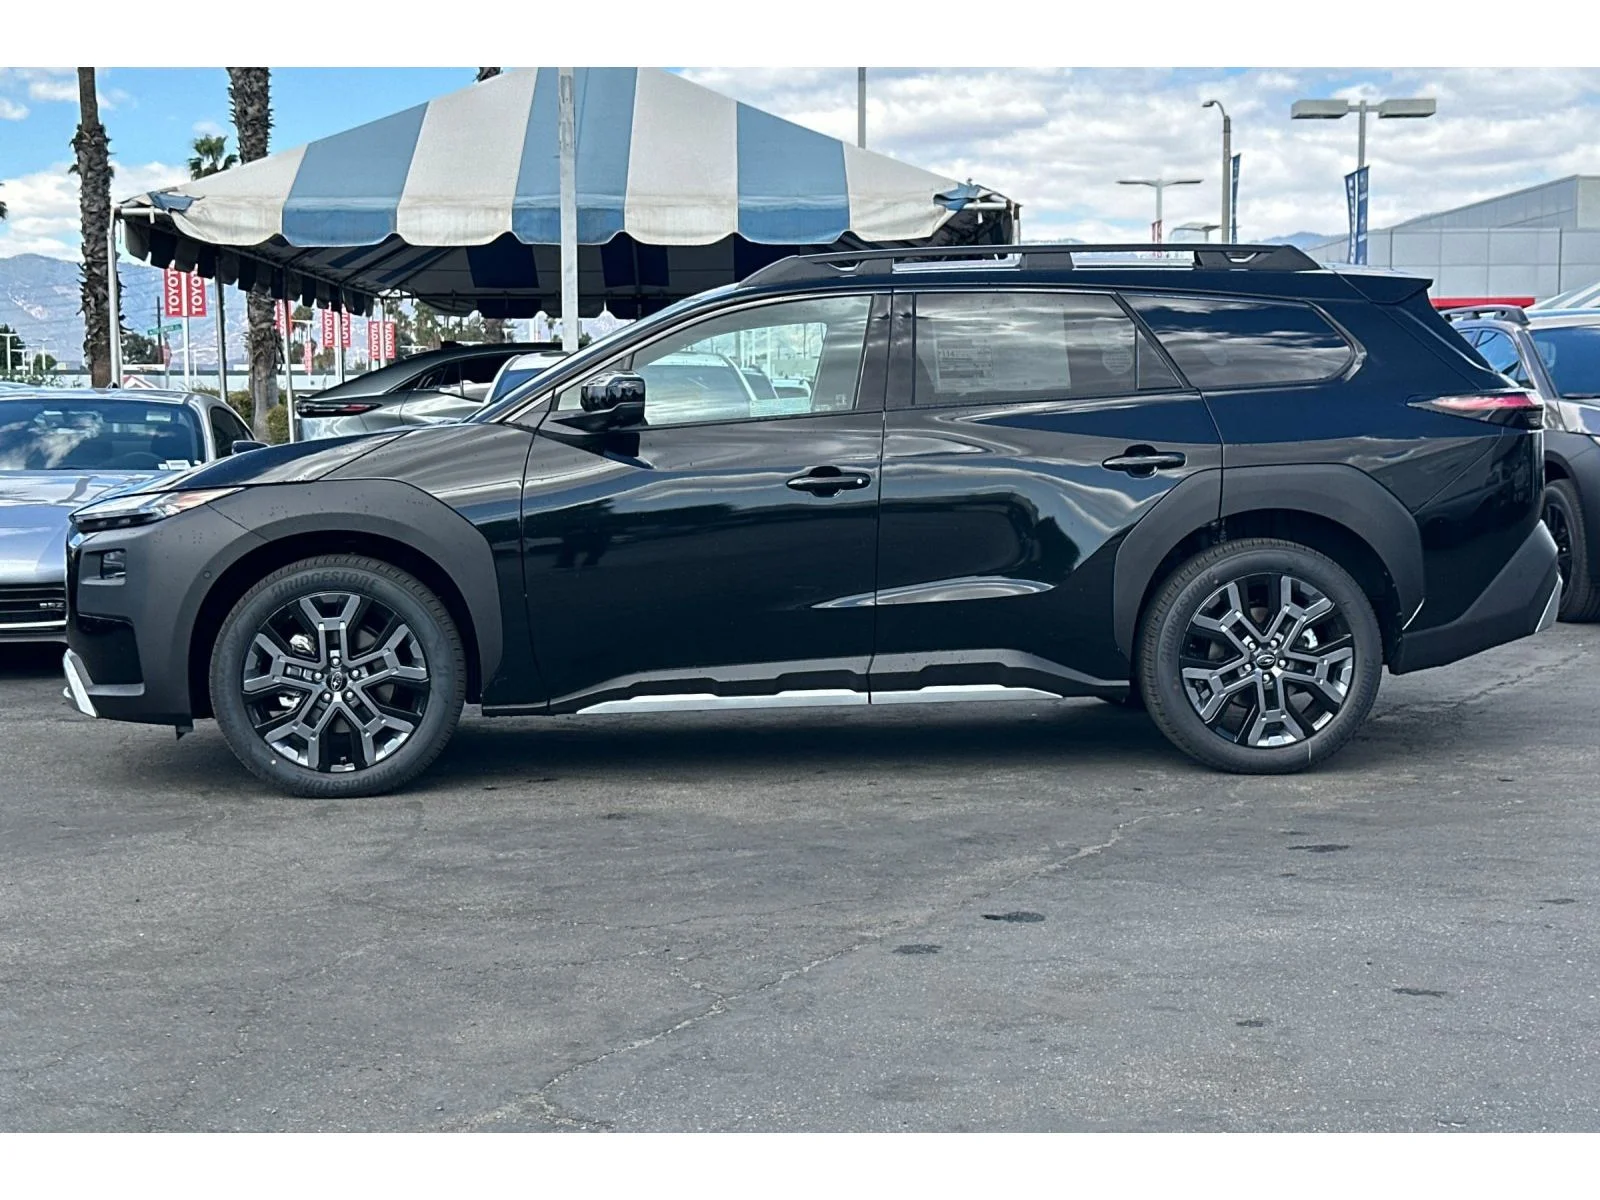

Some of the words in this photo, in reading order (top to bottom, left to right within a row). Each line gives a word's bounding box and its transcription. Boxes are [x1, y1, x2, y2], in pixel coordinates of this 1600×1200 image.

[167, 268, 180, 315] TOYOT
[371, 323, 379, 357] TOYOTA
[385, 323, 393, 357] TOYOTA
[272, 571, 378, 598] BRIDGESTONE
